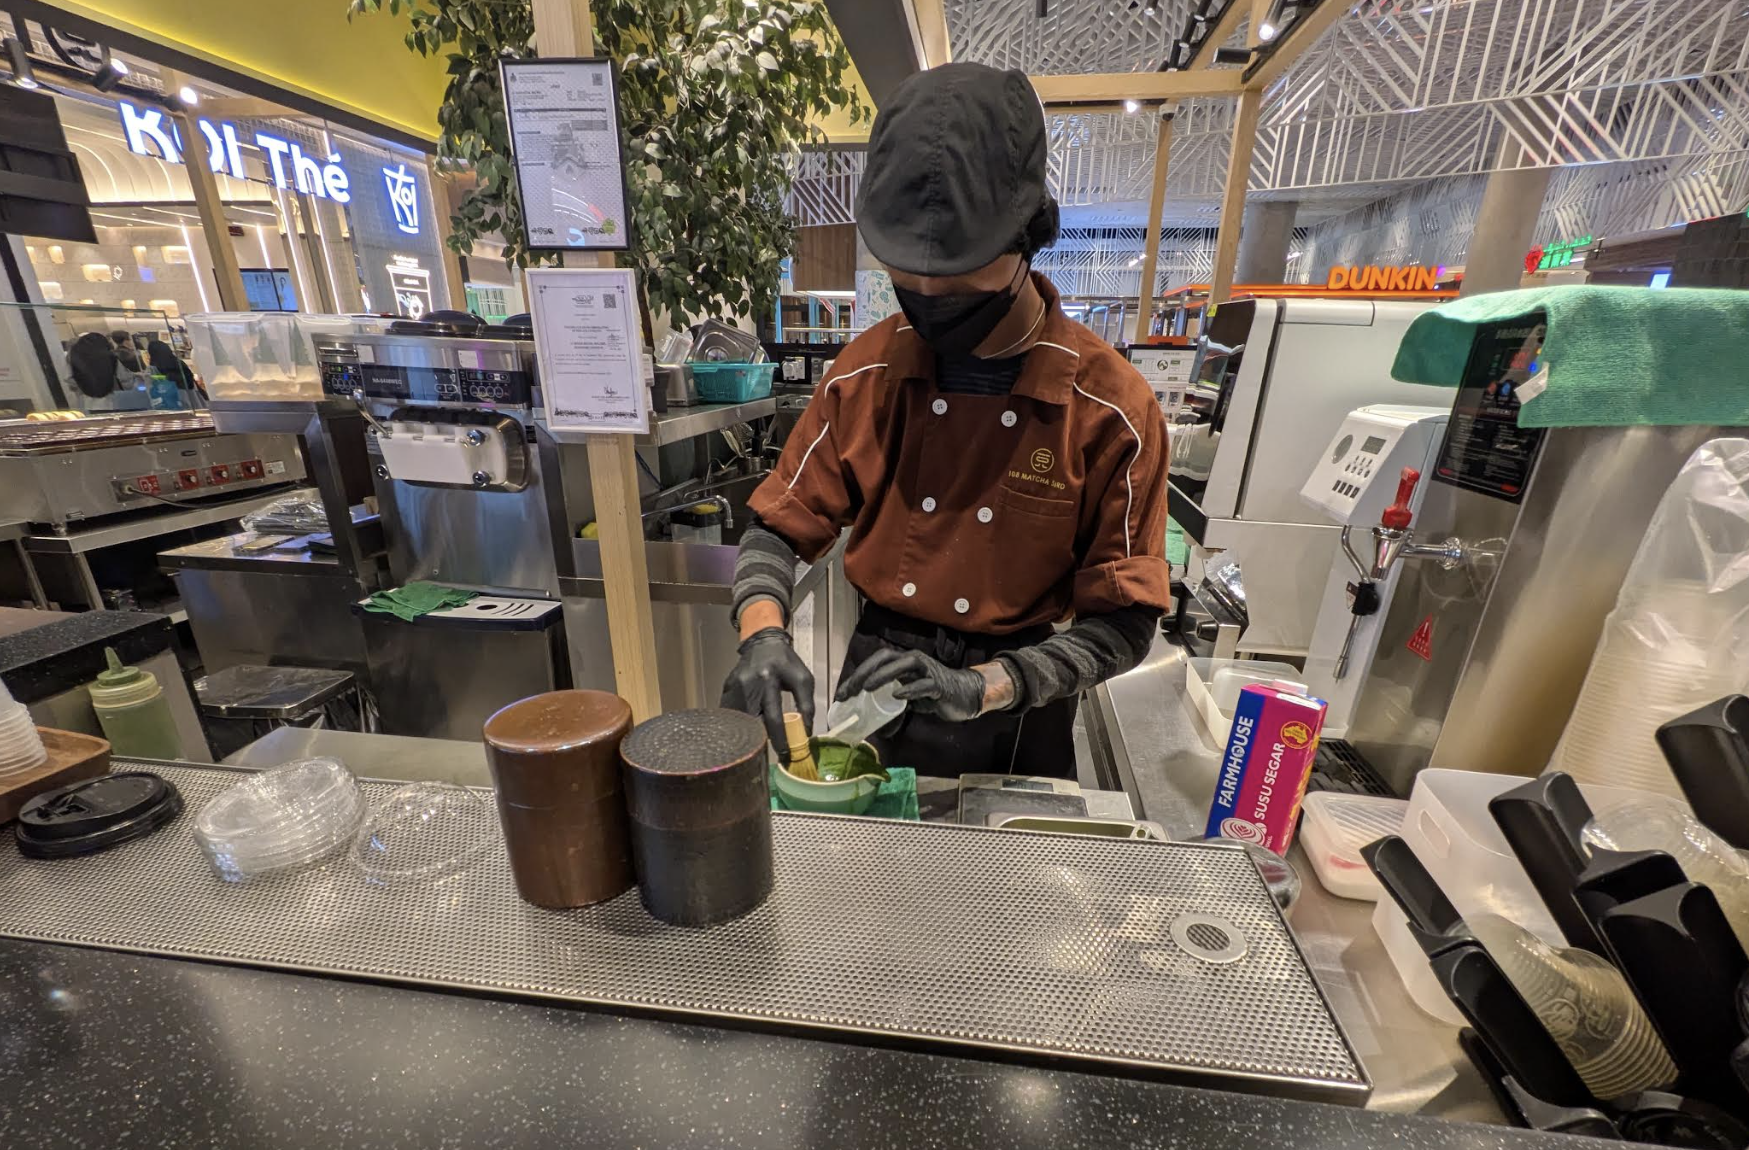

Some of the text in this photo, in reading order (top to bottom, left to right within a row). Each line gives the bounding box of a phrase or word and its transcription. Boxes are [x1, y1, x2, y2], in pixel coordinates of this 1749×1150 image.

[255, 133, 351, 203] Thé
[1021, 473, 1049, 485] MATCHA
[1218, 716, 1254, 808] FARMHOUSE
[1254, 785, 1273, 820] SUSU
[1264, 742, 1286, 786] SEGAR
